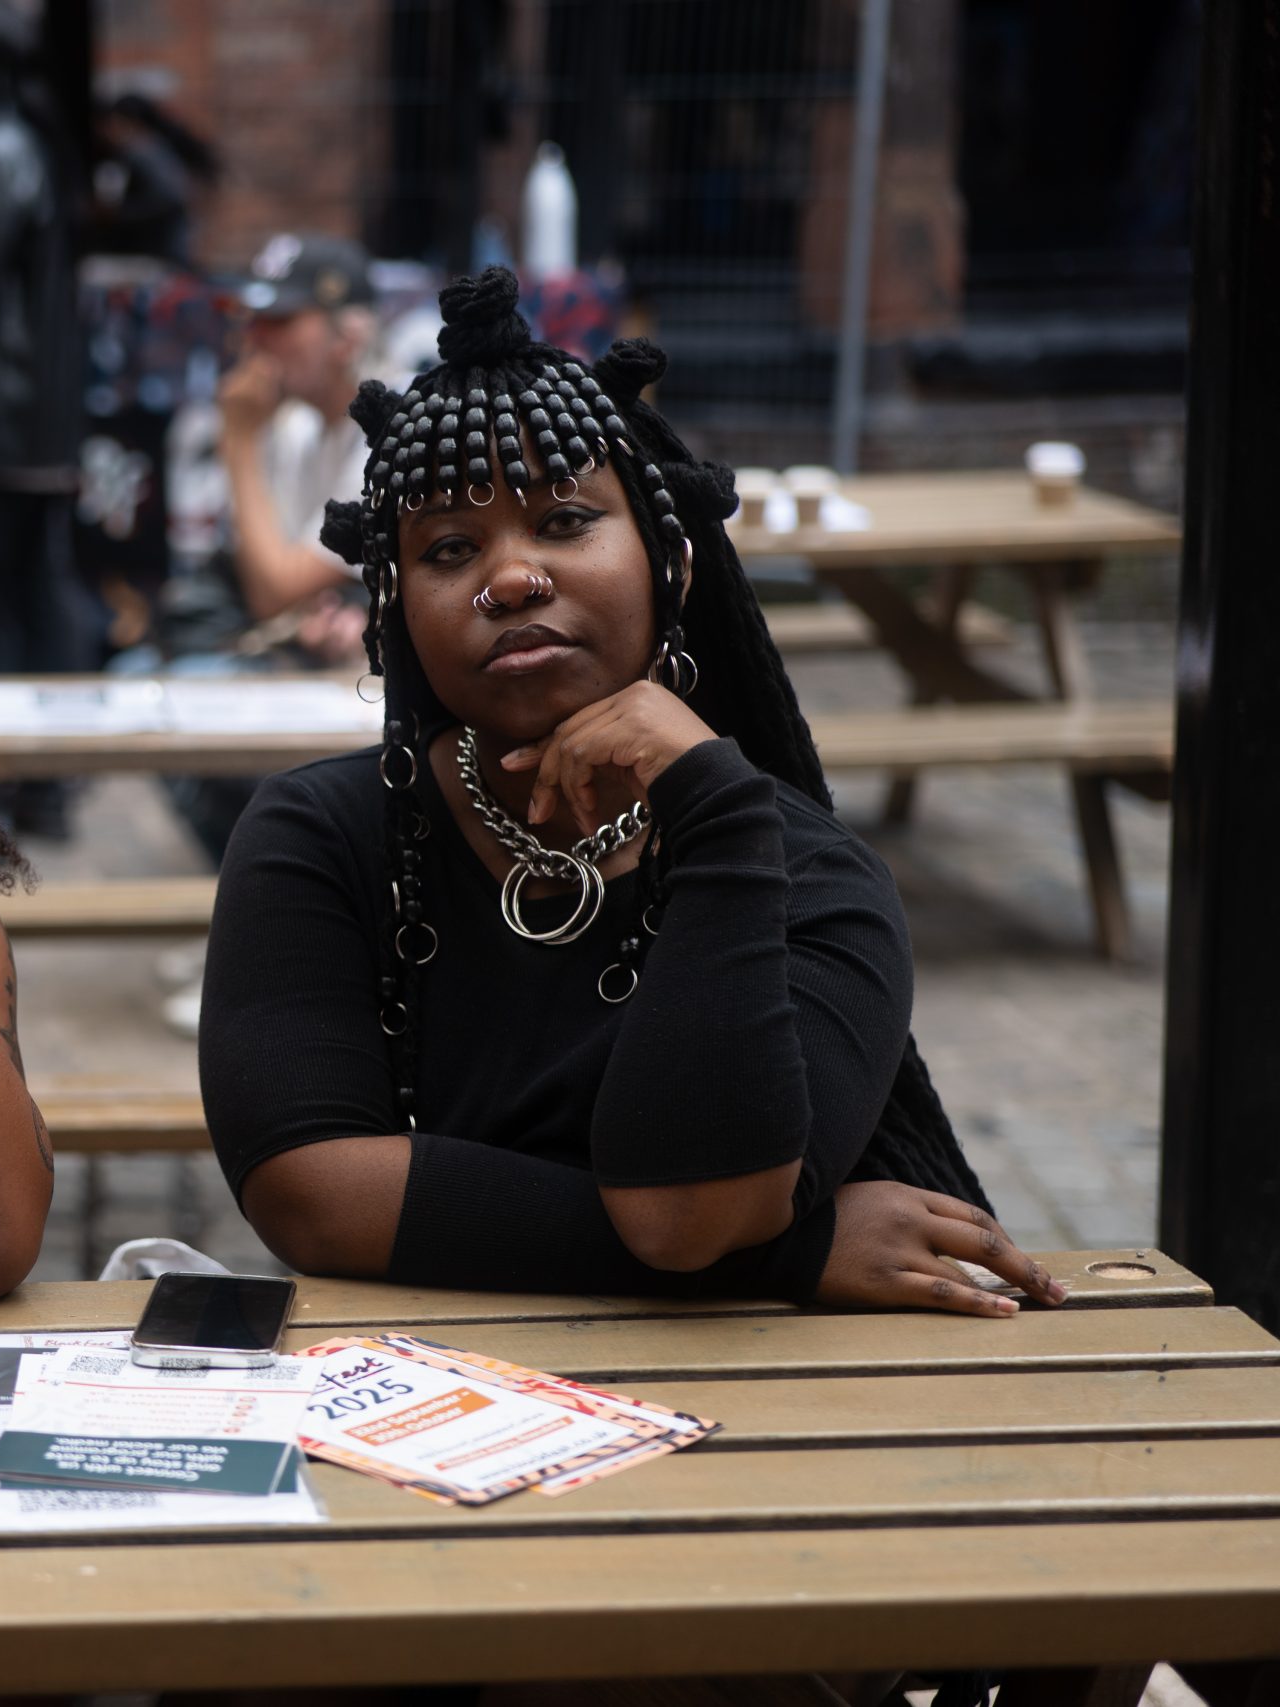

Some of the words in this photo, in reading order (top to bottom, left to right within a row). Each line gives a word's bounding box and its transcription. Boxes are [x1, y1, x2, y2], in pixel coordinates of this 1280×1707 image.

[306, 1378, 414, 1420] 2025
[48, 1444, 150, 1458] programme
[112, 1440, 165, 1450] social
[167, 1443, 199, 1453] our
[200, 1445, 229, 1455] via
[44, 1451, 86, 1463] date
[88, 1453, 110, 1465] to
[113, 1455, 137, 1467] up
[151, 1450, 182, 1461] our
[185, 1452, 225, 1464] with
[56, 1460, 81, 1471] us
[82, 1462, 123, 1474] with
[140, 1456, 182, 1470] stay
[184, 1459, 222, 1473] and
[125, 1466, 199, 1482] Connect
